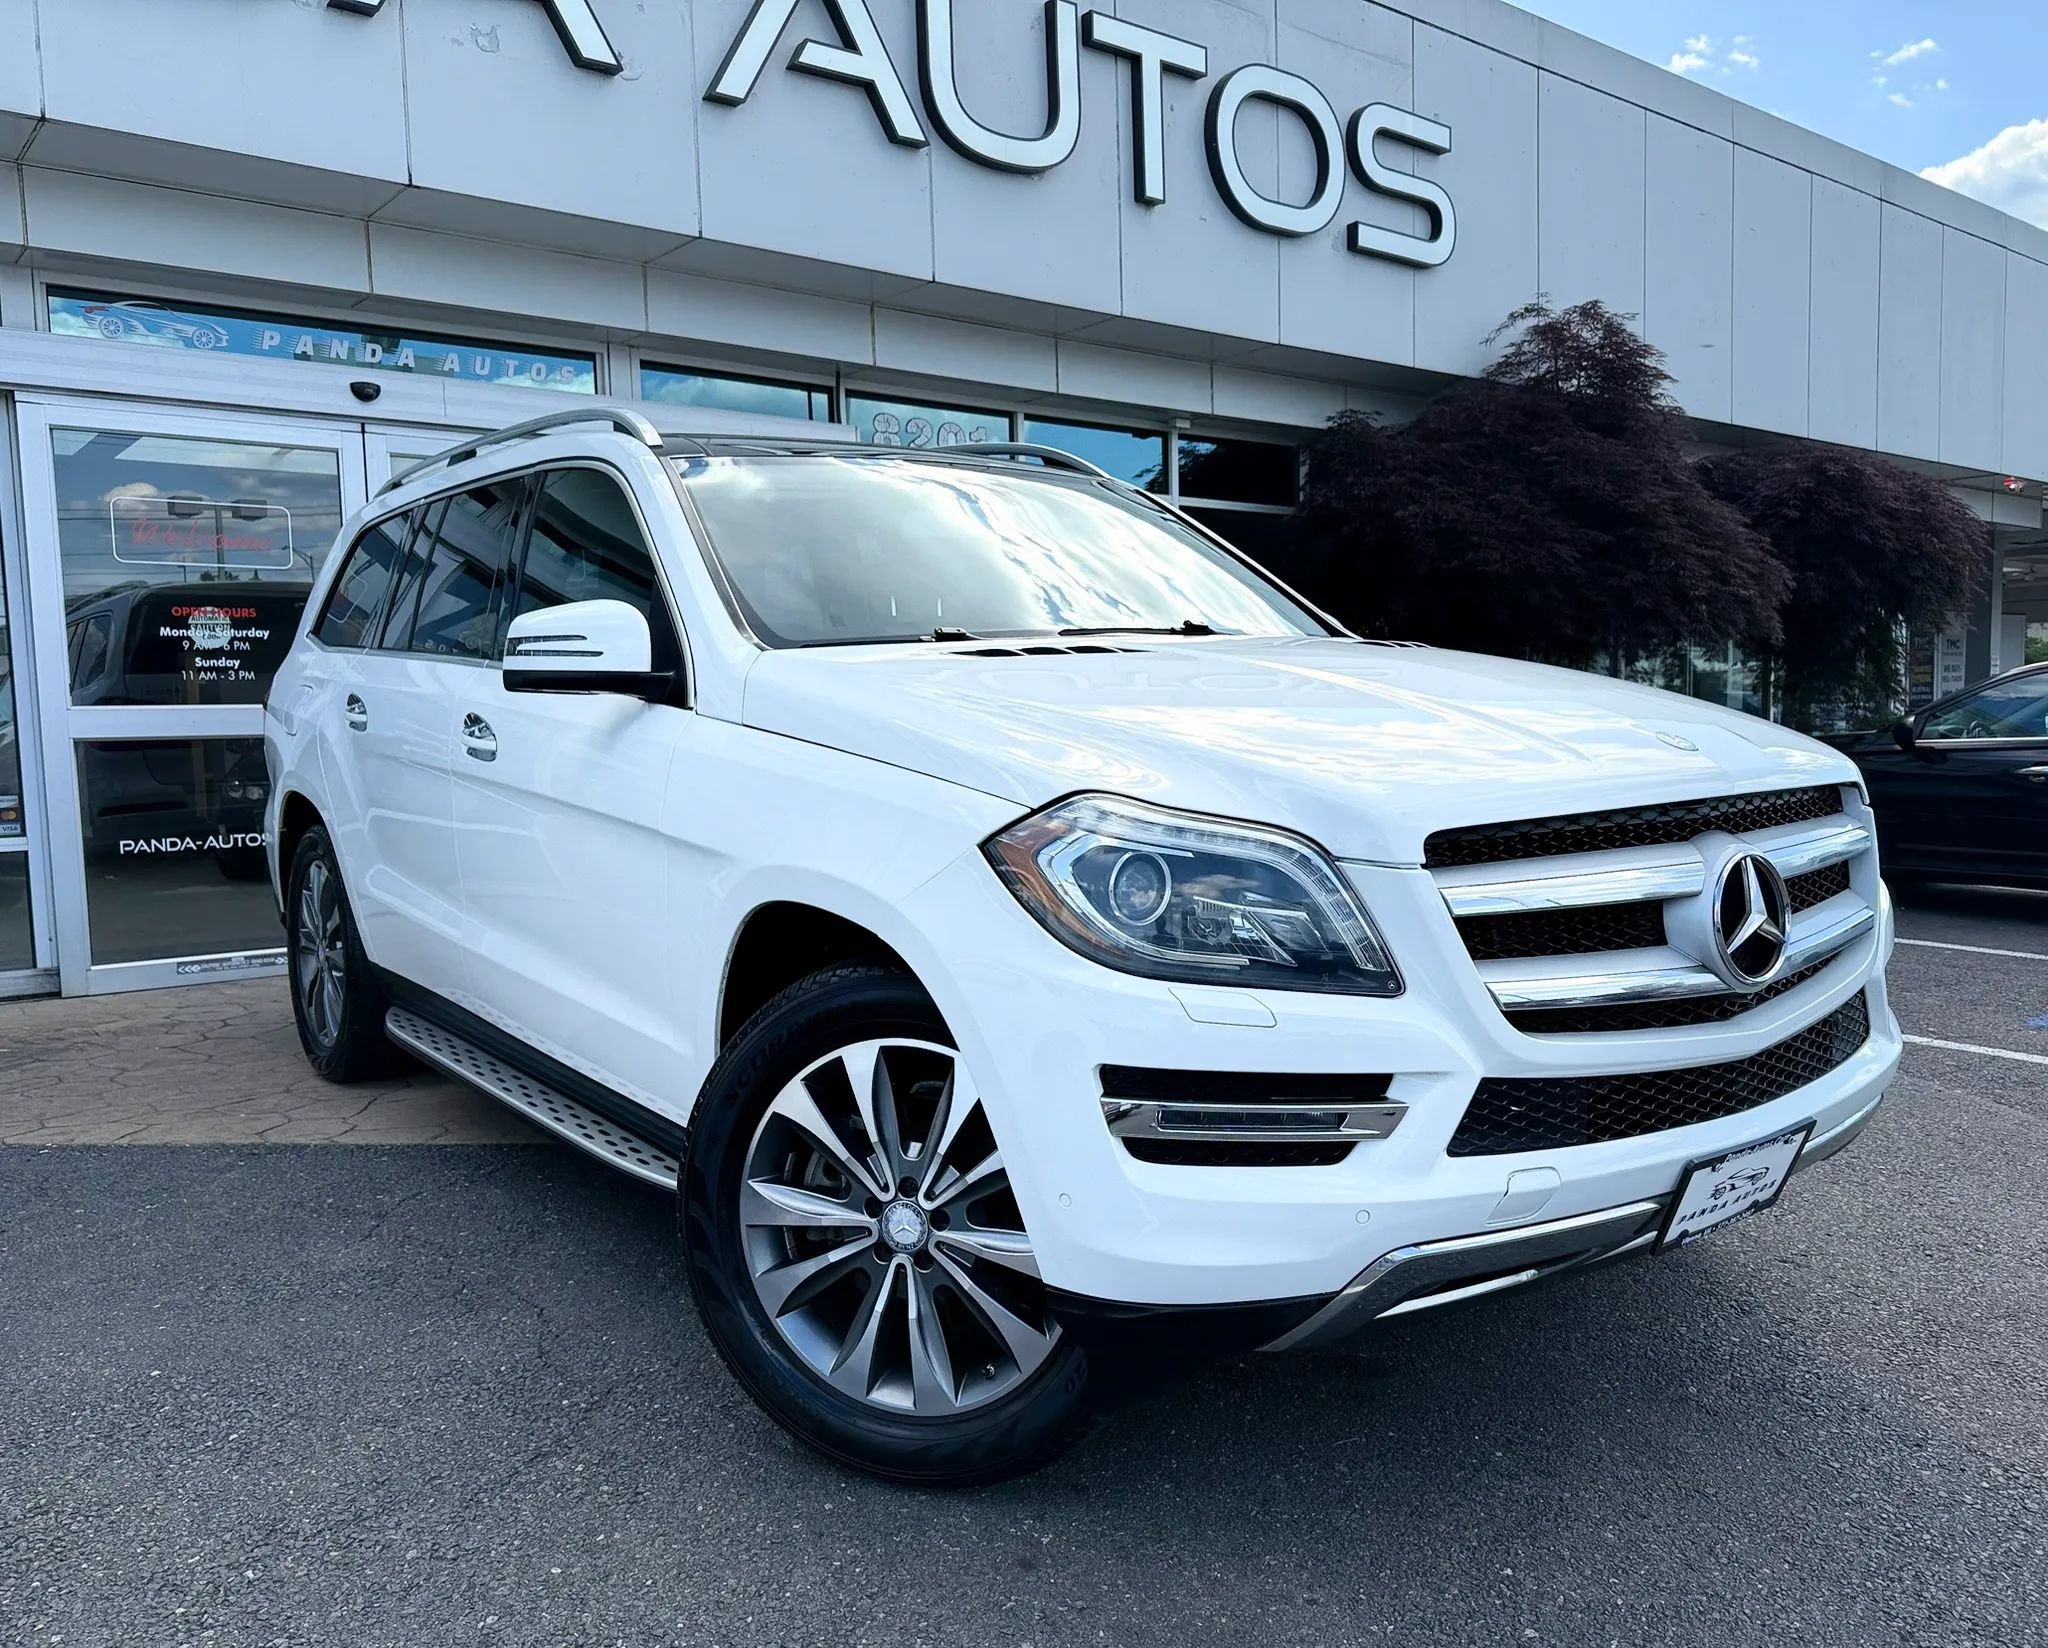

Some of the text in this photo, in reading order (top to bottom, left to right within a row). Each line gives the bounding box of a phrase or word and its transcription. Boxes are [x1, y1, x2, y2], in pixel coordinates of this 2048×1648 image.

[702, 0, 1456, 270] AUTOS
[255, 328, 575, 385] PANDA AUTOS
[182, 640, 190, 651] 9
[233, 641, 251, 651] PM
[182, 670, 194, 680] 11
[198, 671, 218, 681] AM
[228, 670, 236, 681] 3
[239, 671, 256, 681] PM
[194, 656, 241, 669] Sunday
[1677, 1179, 1777, 1226] PANDA AUTOS
